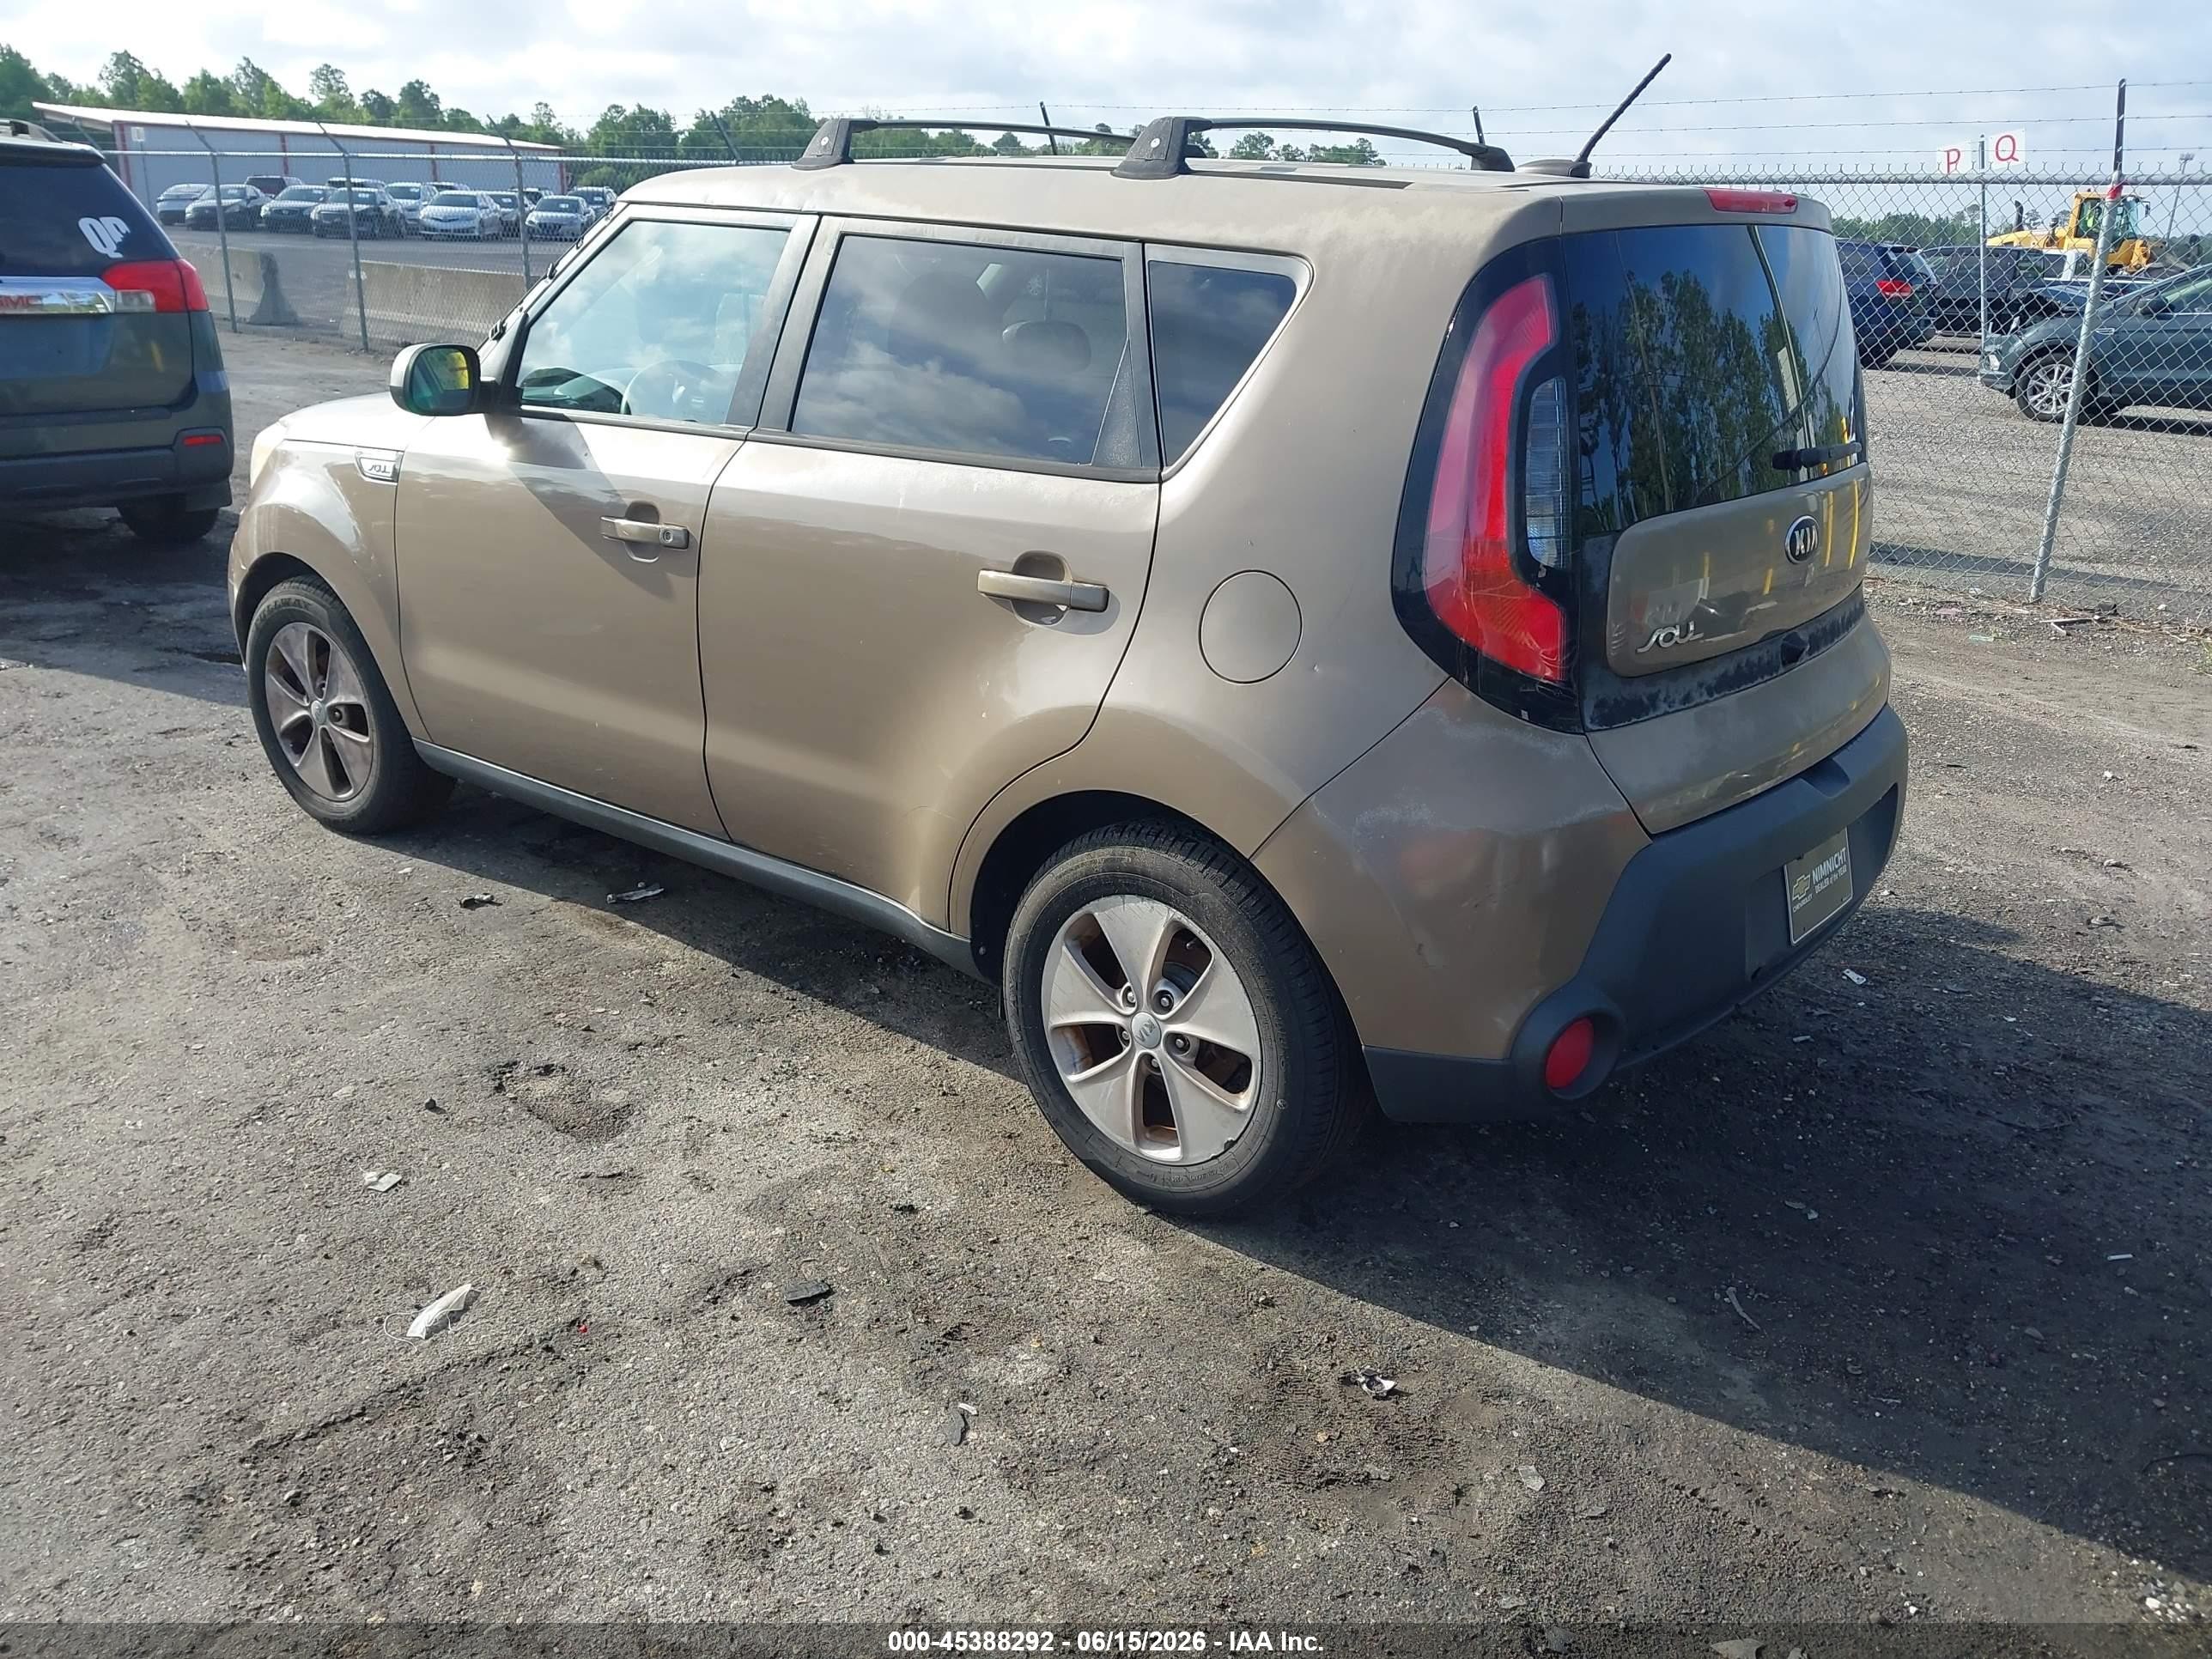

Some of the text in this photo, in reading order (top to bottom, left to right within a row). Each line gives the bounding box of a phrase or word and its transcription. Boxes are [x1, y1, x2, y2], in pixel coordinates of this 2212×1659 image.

[1944, 148, 1961, 174] P
[1995, 134, 2019, 162] Q
[1794, 526, 1818, 556] KIA
[1636, 620, 1705, 653] SOUL
[1812, 847, 1846, 885] NIMNICHT
[1135, 1018, 1156, 1042] KIA
